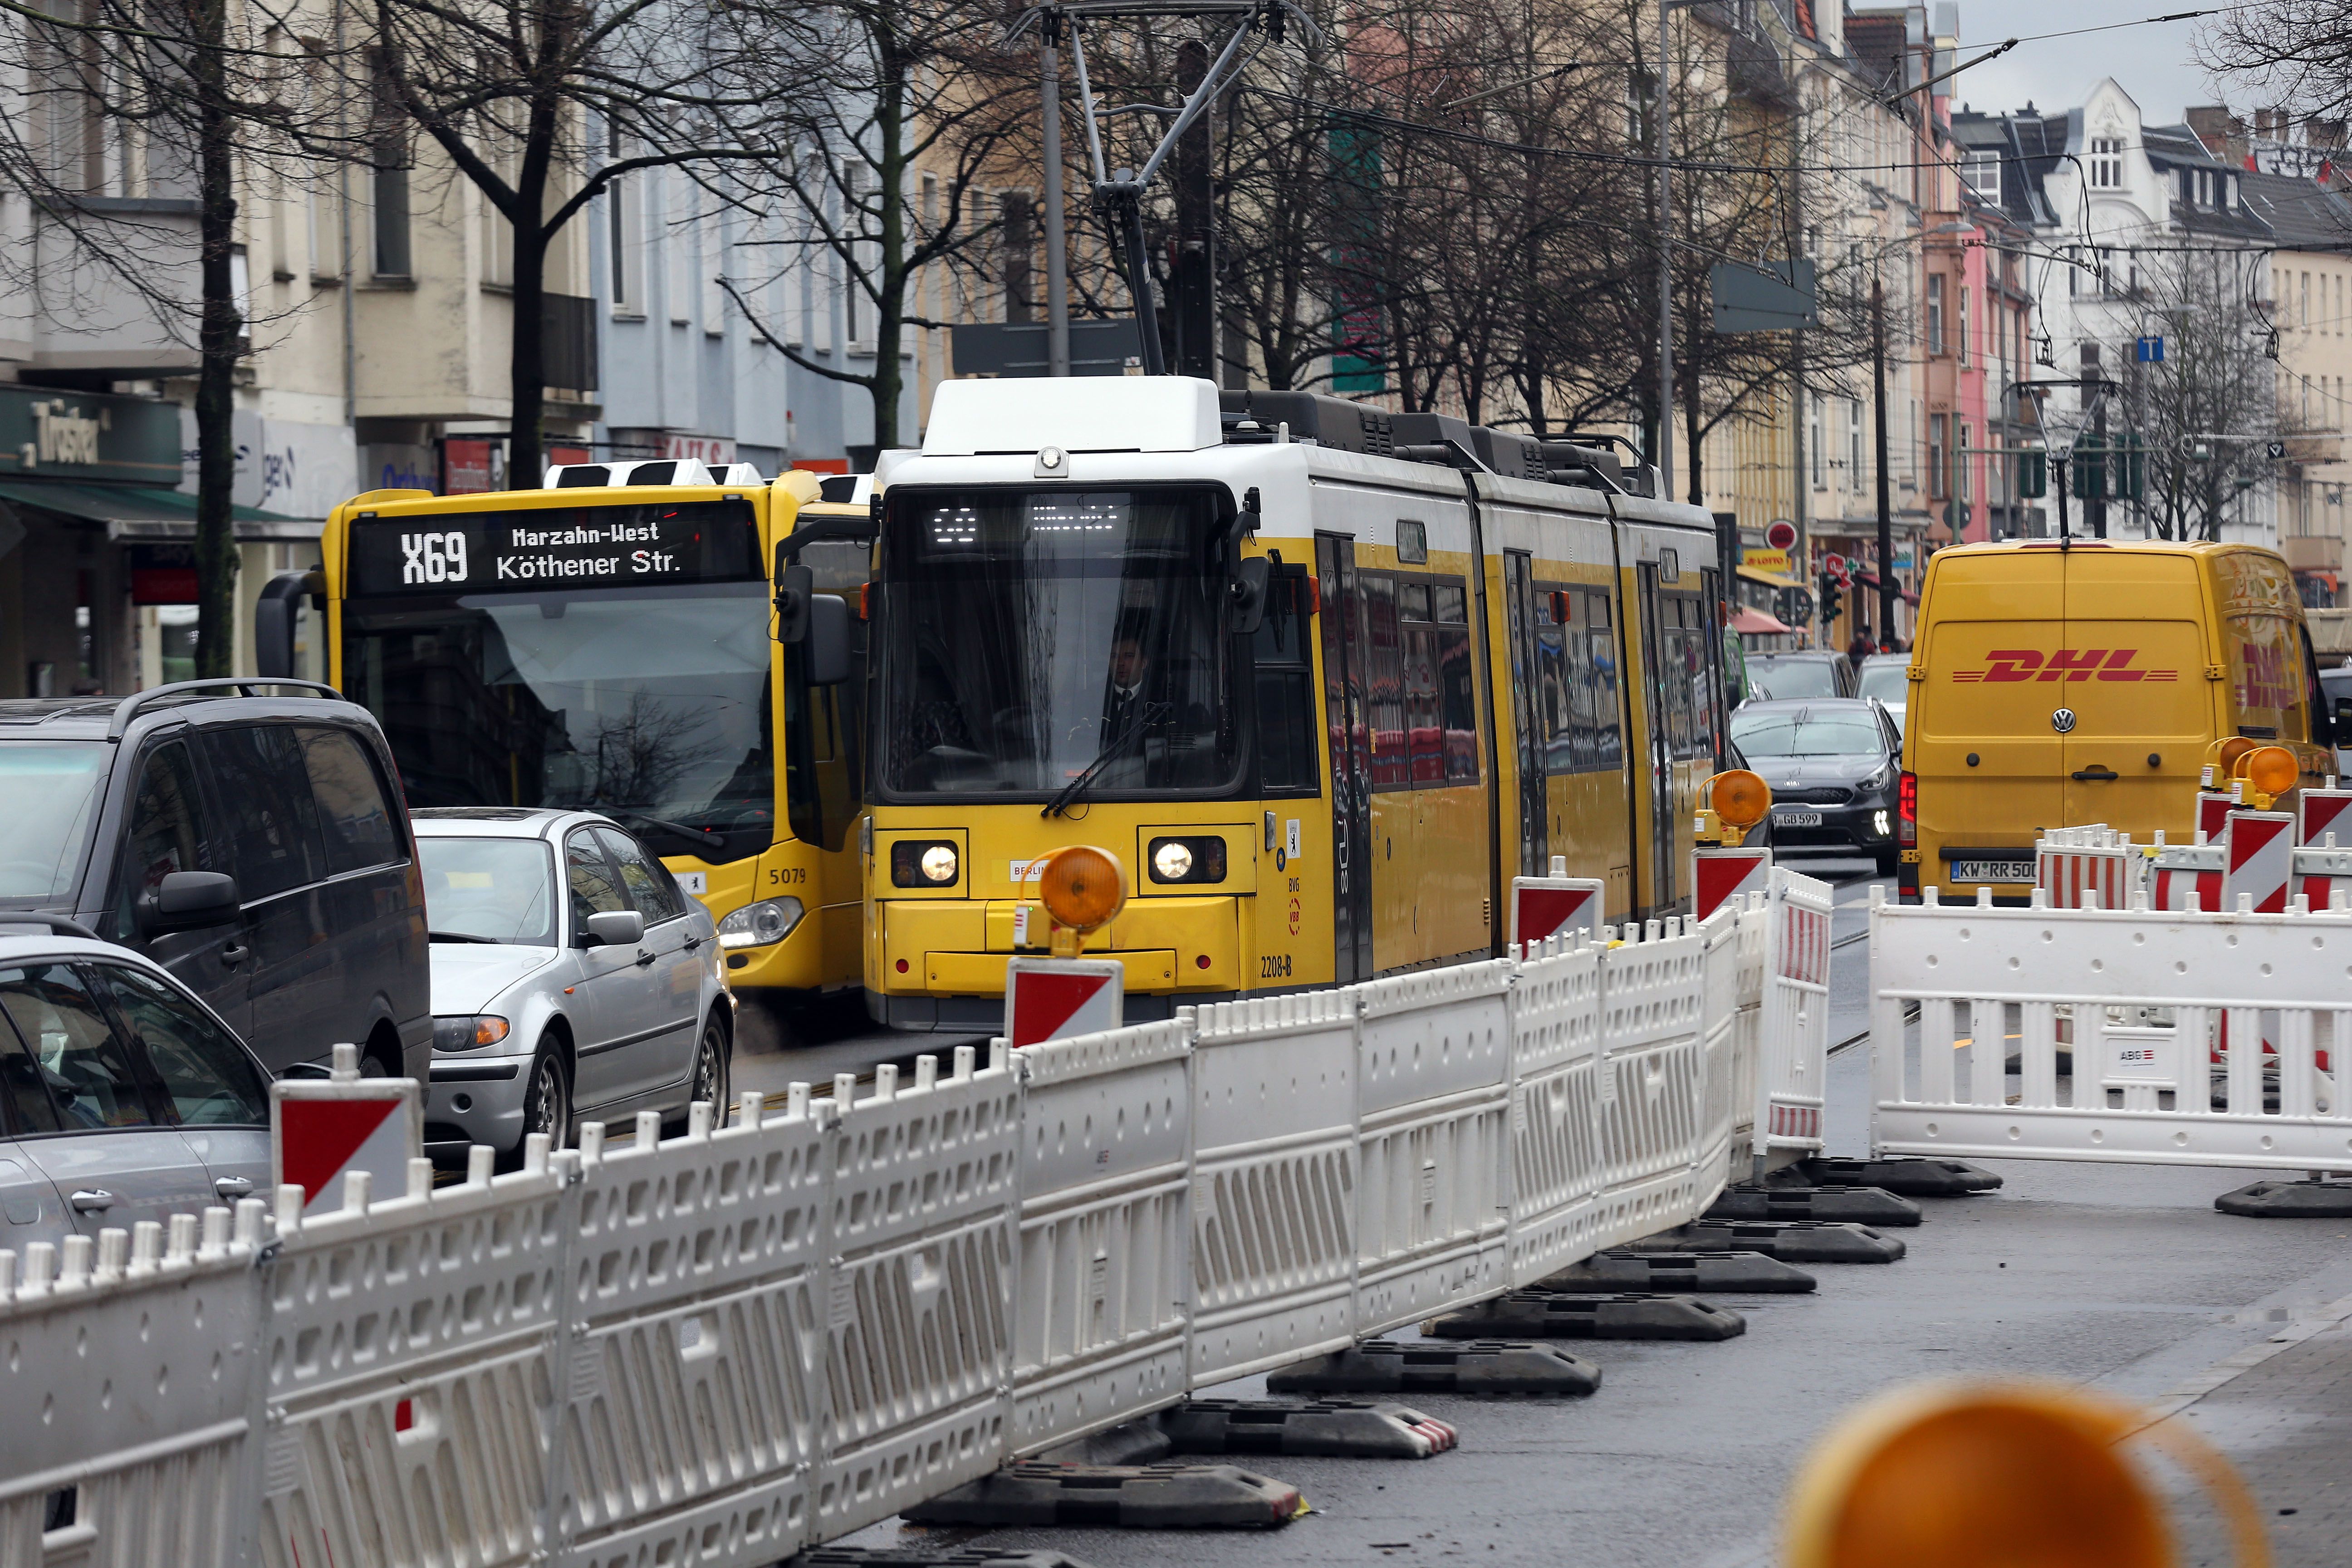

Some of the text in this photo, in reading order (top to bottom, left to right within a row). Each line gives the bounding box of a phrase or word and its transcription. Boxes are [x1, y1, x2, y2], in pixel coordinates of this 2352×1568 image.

[512, 523, 660, 547] Marzahn-West
[401, 531, 467, 584] X69
[497, 550, 680, 579] Köthener Str.
[1982, 649, 2148, 681] DHL
[1784, 814, 1797, 824] GB
[1798, 814, 1818, 824] 599
[770, 868, 806, 884] 5079
[1960, 863, 1980, 877] KW
[1990, 863, 2009, 877] RR
[1289, 877, 1299, 892] BVG
[1289, 911, 1299, 923] VBB
[1261, 954, 1292, 978] 2208-B
[2120, 1050, 2142, 1060] ABG
